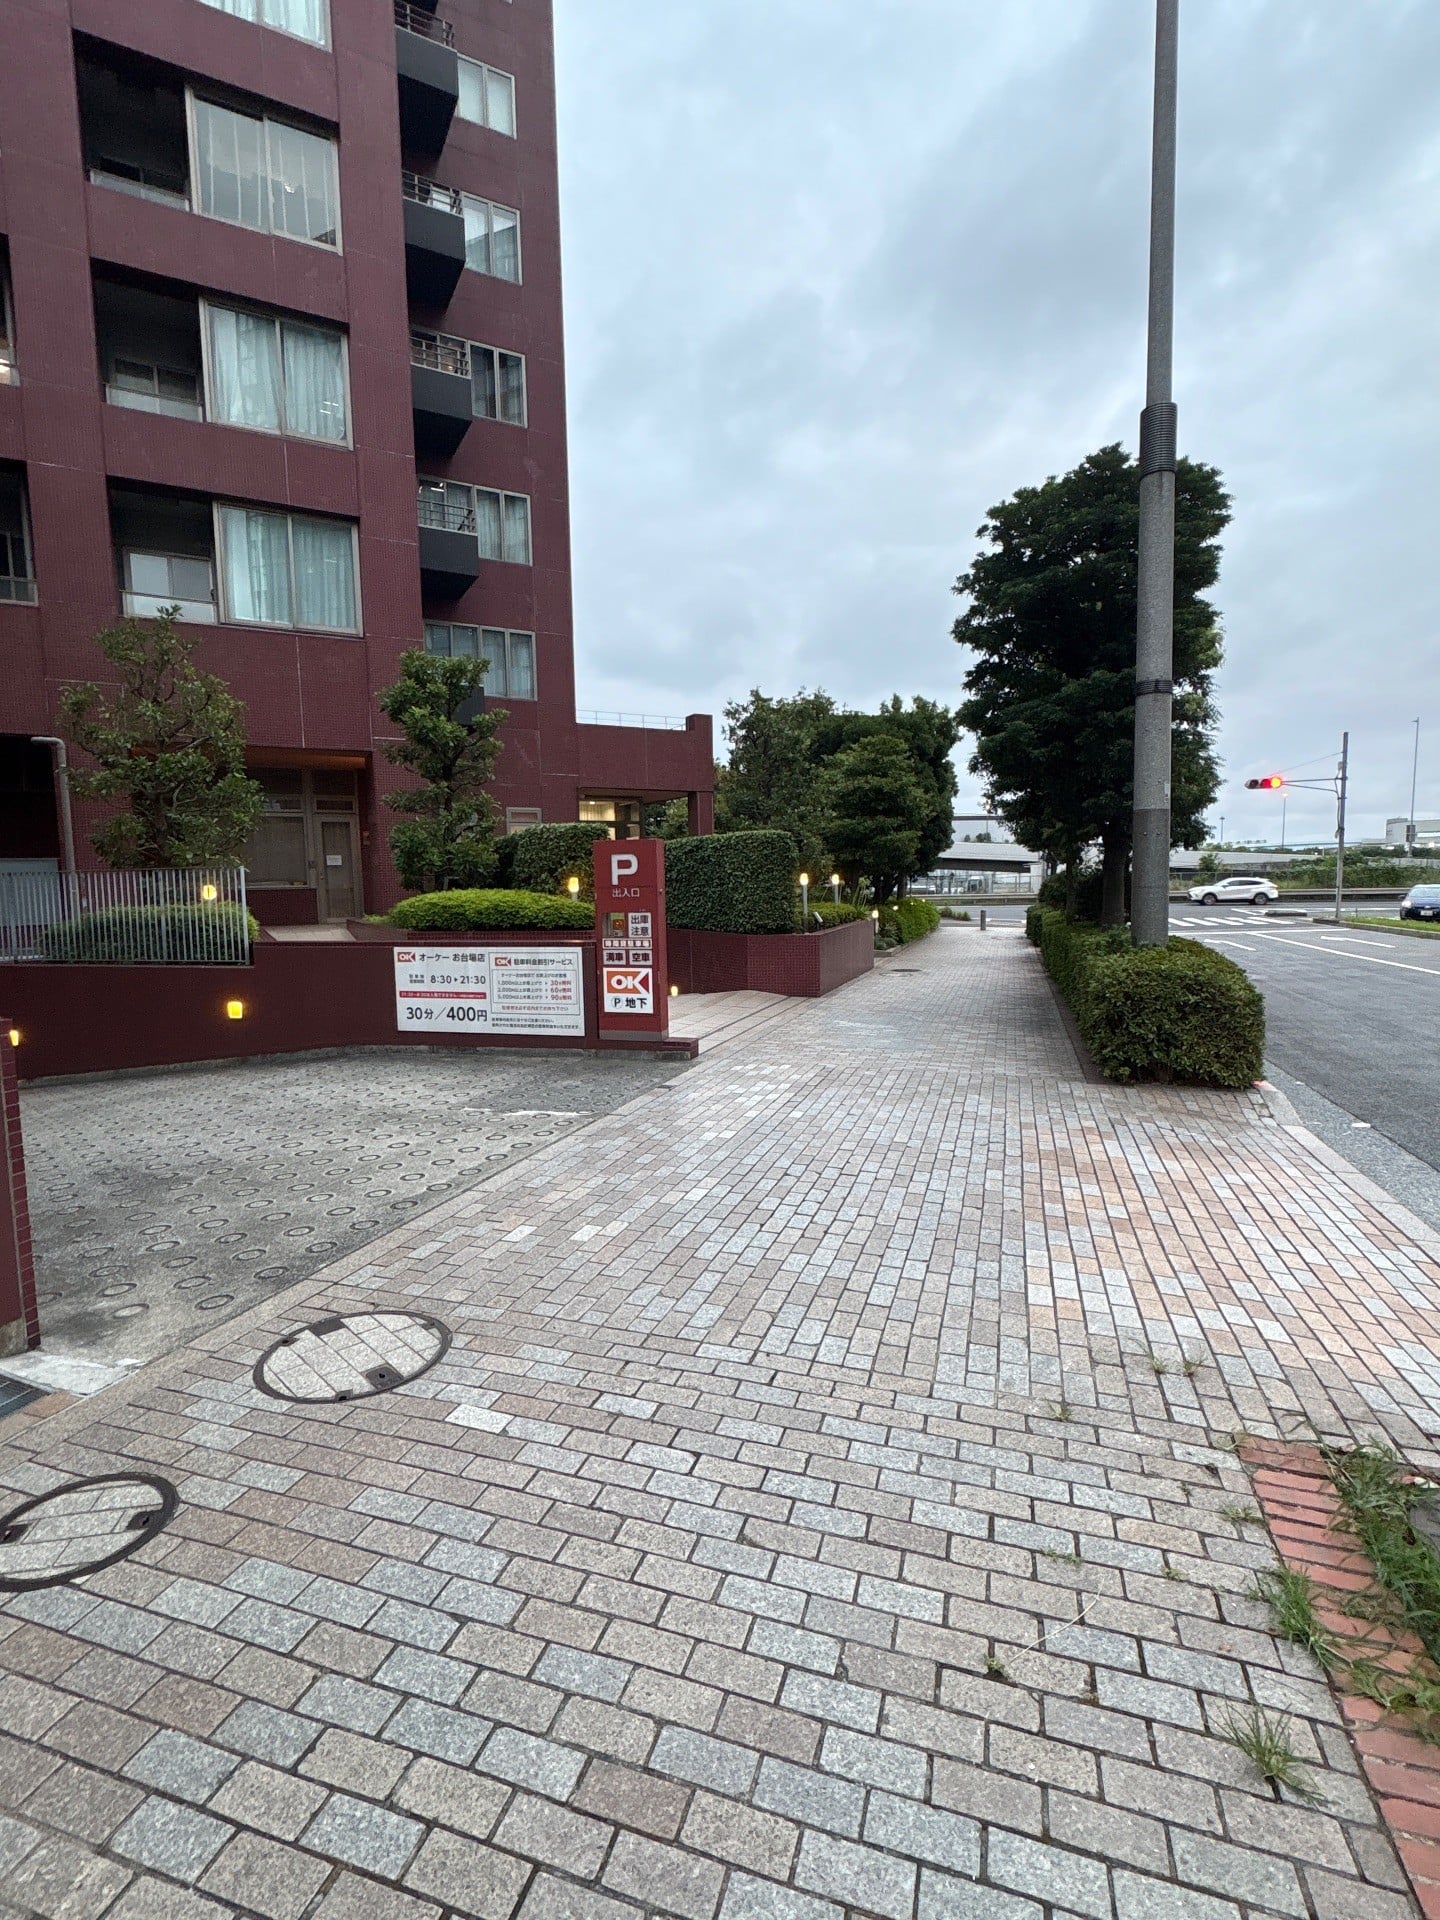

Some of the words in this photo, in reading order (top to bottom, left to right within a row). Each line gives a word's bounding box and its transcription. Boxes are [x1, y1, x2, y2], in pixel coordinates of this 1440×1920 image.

[611, 854, 638, 885] P
[612, 888, 640, 897] 出入口
[397, 952, 416, 963] OK
[419, 953, 450, 962] オーケー
[452, 953, 486, 963] お台場店
[495, 957, 511, 966] OK
[430, 975, 452, 984] 8:30
[460, 975, 486, 985] 21:30
[611, 969, 649, 994] OK
[625, 997, 648, 1009] 地下
